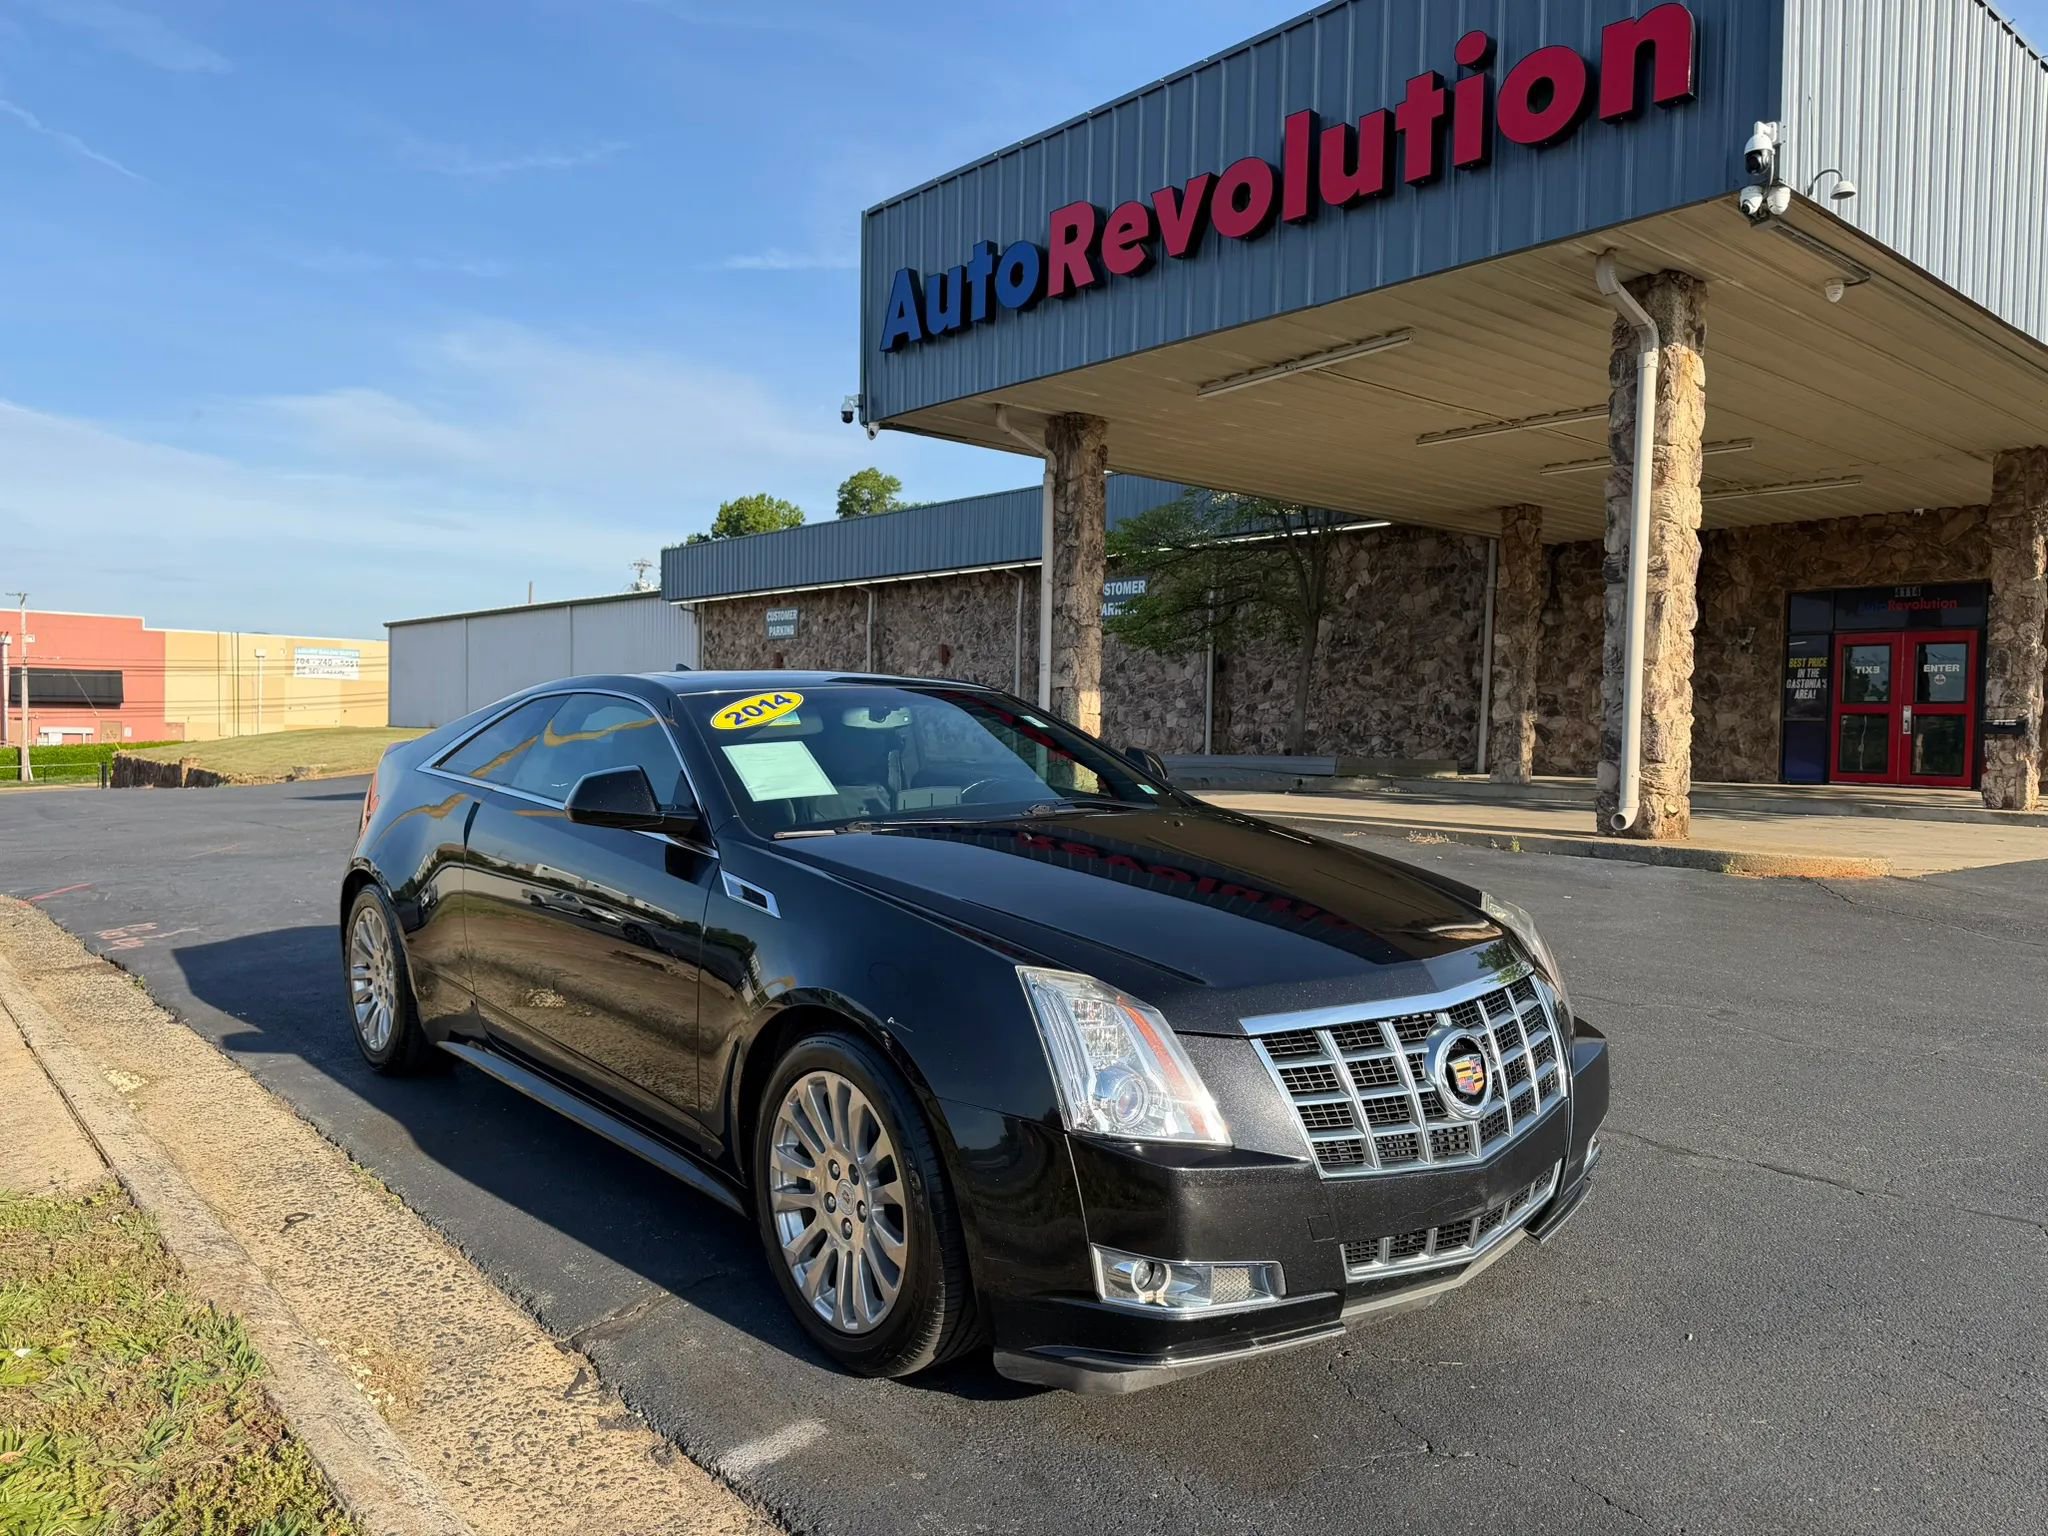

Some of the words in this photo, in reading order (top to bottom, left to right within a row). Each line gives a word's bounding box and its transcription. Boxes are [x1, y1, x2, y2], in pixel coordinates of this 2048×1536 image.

[767, 610, 798, 621] CUSTOMER
[769, 625, 795, 637] PARKING
[1789, 657, 1807, 668] BEST
[1808, 657, 1828, 668] PRICE
[1797, 668, 1806, 678] IN
[1807, 668, 1820, 678] THE
[1923, 664, 1960, 673] ENTER
[1786, 678, 1828, 689] GASTONIA'S
[1794, 689, 1817, 700] AREA!
[724, 693, 793, 726] 2014
